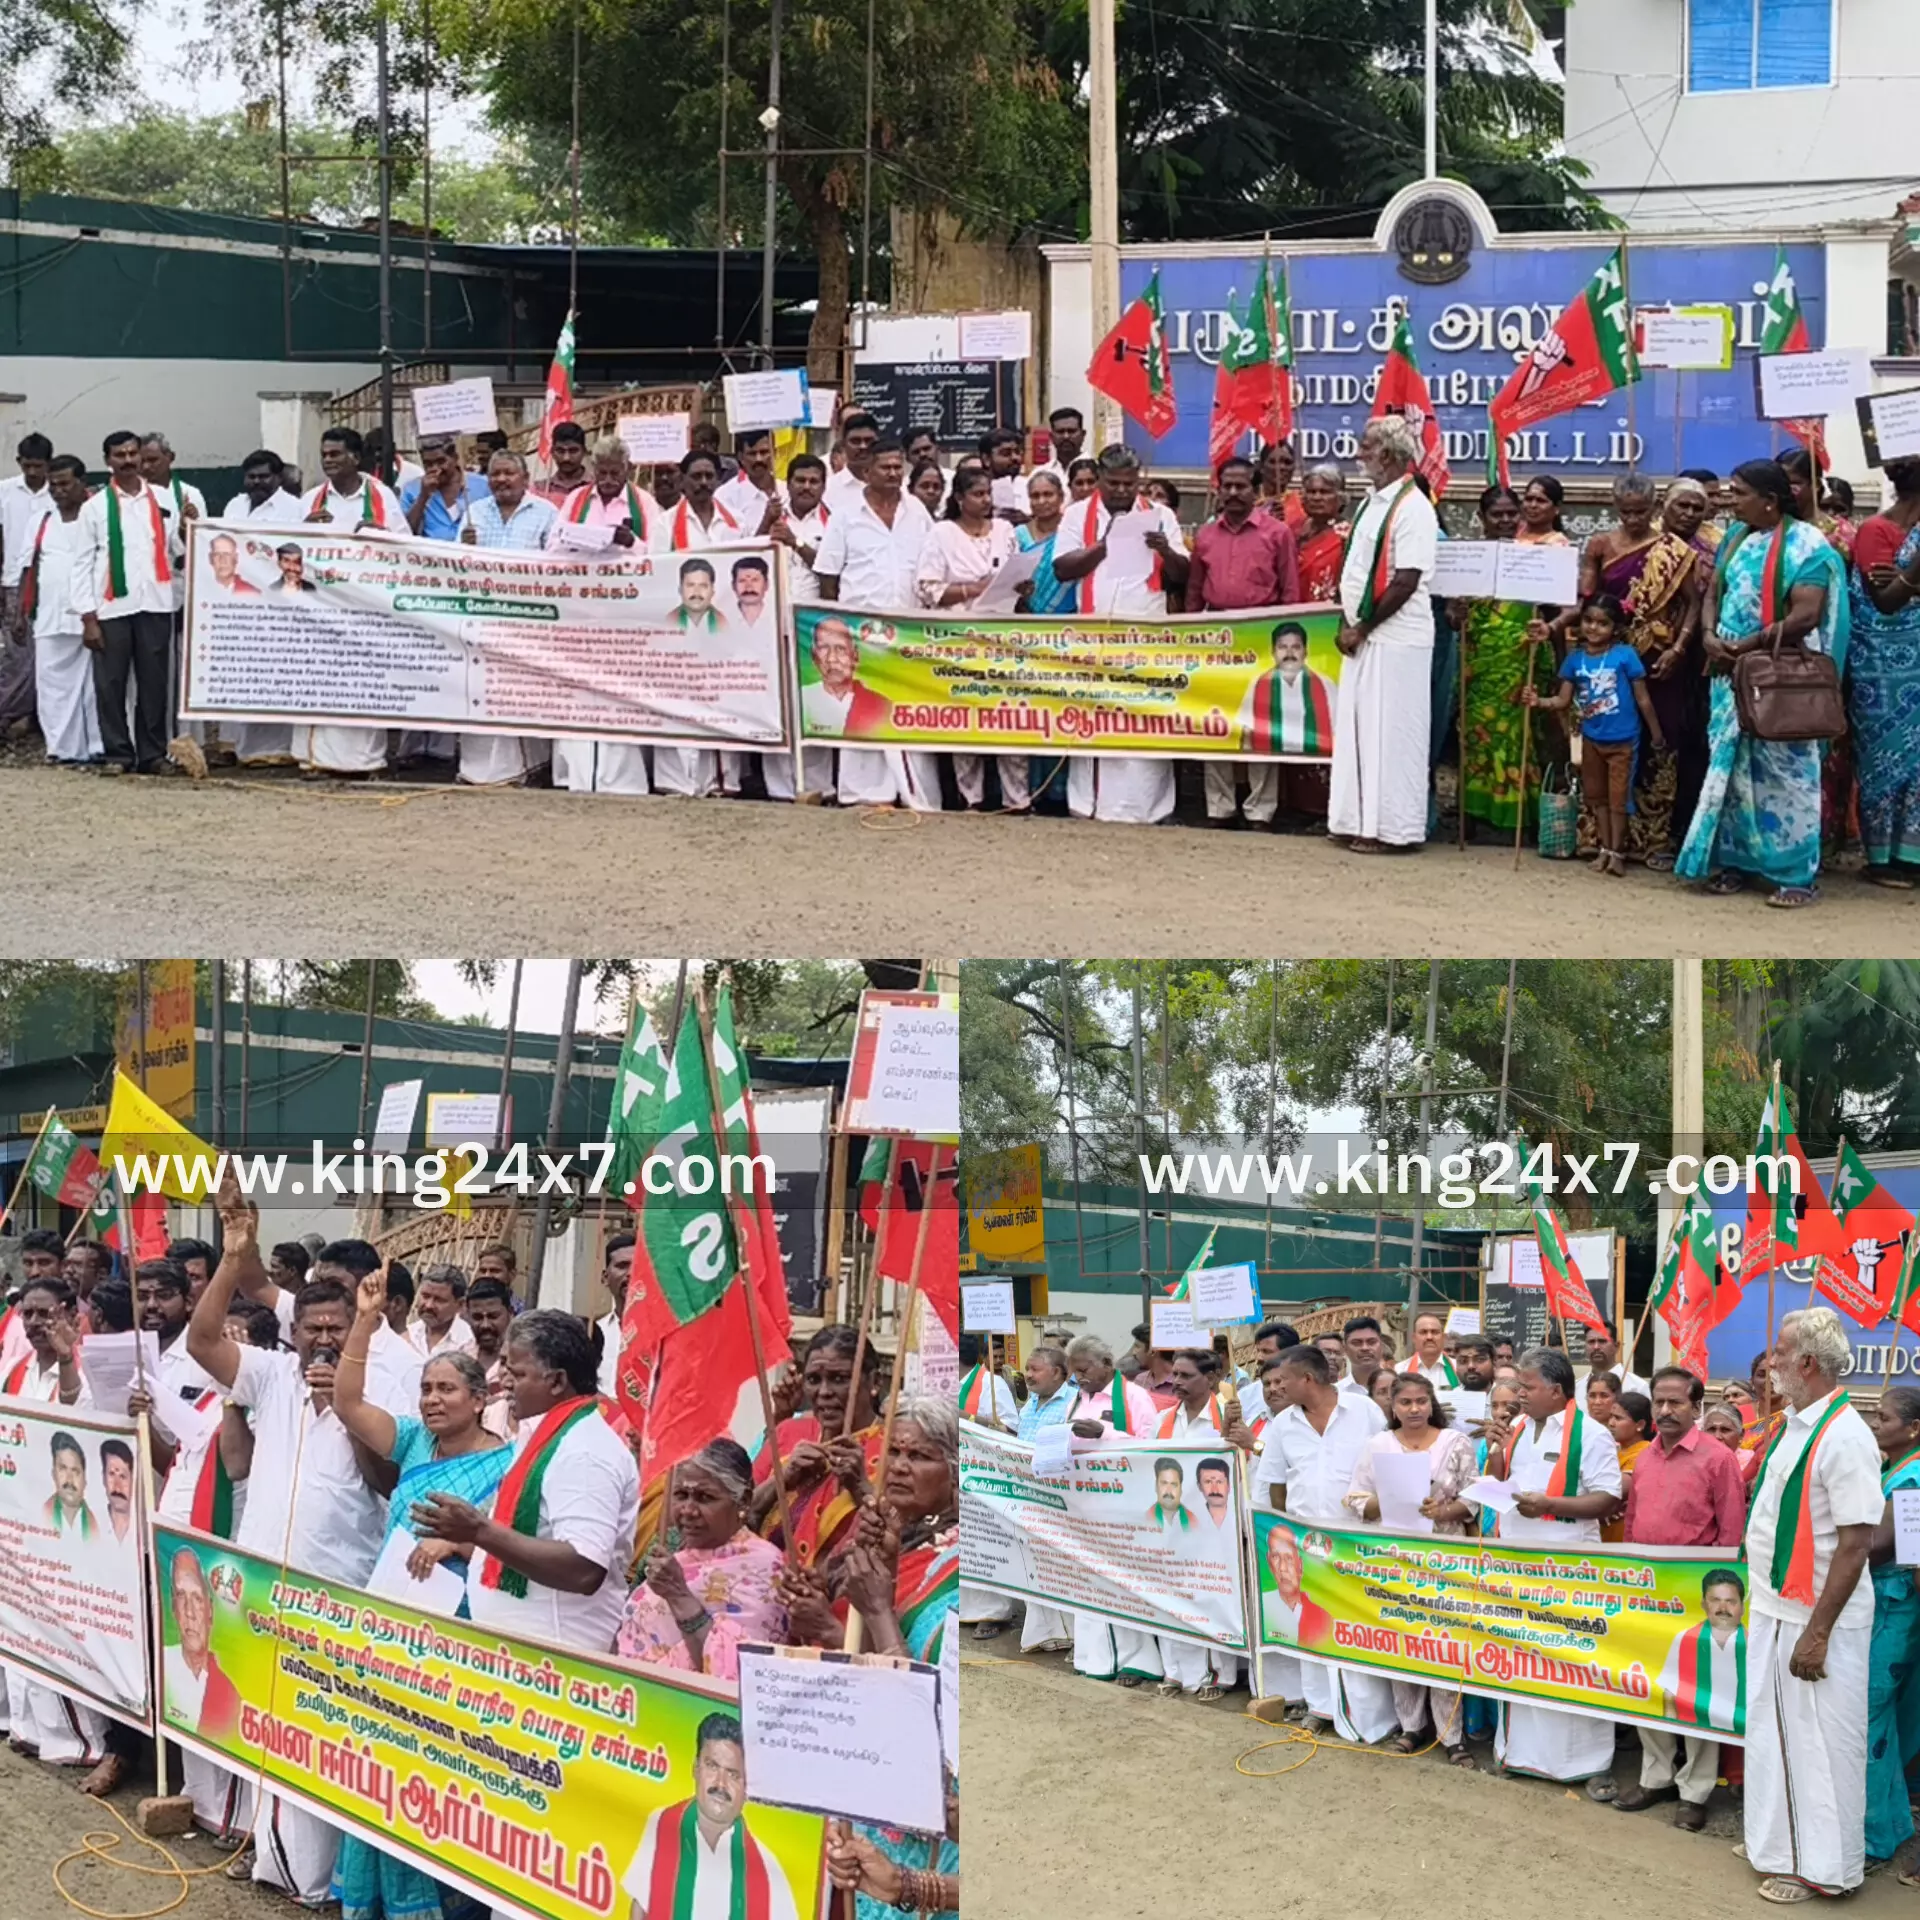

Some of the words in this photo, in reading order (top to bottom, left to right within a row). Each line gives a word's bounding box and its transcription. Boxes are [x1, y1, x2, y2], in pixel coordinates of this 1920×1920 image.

[579, 582, 639, 600] சங்கம்
[892, 703, 970, 730] கவன
[977, 700, 1051, 739] ஈர்ப்பு
[1056, 702, 1229, 739] ஆர்ப்பாட்டம்
[1075, 1480, 1125, 1495] சங்கம்
[1428, 1551, 1599, 1582] தொழிலாளர்கள்
[1603, 1567, 1655, 1589] கட்சி
[1519, 1585, 1567, 1608] மாநில
[1572, 1592, 1622, 1616] பொது
[1628, 1596, 1686, 1615] சங்கம்
[272, 1583, 356, 1629] புரட்சிகர
[361, 1608, 563, 1698] தொழிலாளர்கள்
[569, 1678, 637, 1725] கட்சி
[1335, 1620, 1399, 1655] கவன
[1403, 1629, 1472, 1676] ஈர்ப்பு
[1475, 1641, 1650, 1700] ஆர்ப்பாட்டம்
[1487, 1623, 1596, 1651] அவர்களுக்கு
[280, 1655, 332, 1693] பல்வேறு
[334, 1675, 455, 1741] கோரிக்கைகளை
[461, 1728, 563, 1789] வலியுறுத்தி
[324, 1638, 453, 1703] தொழிலாளர்கள்
[456, 1686, 515, 1726] மாநில
[521, 1708, 586, 1759] பொது
[592, 1732, 670, 1780] சங்கம்
[297, 1691, 348, 1724] தமிழக
[351, 1715, 419, 1756] முதல்வர்
[423, 1741, 547, 1812] அவர்களுக்கு
[241, 1704, 313, 1769] கவன
[319, 1737, 394, 1822] ஈர்ப்பு
[400, 1775, 614, 1913] ஆர்ப்பாட்டம்
